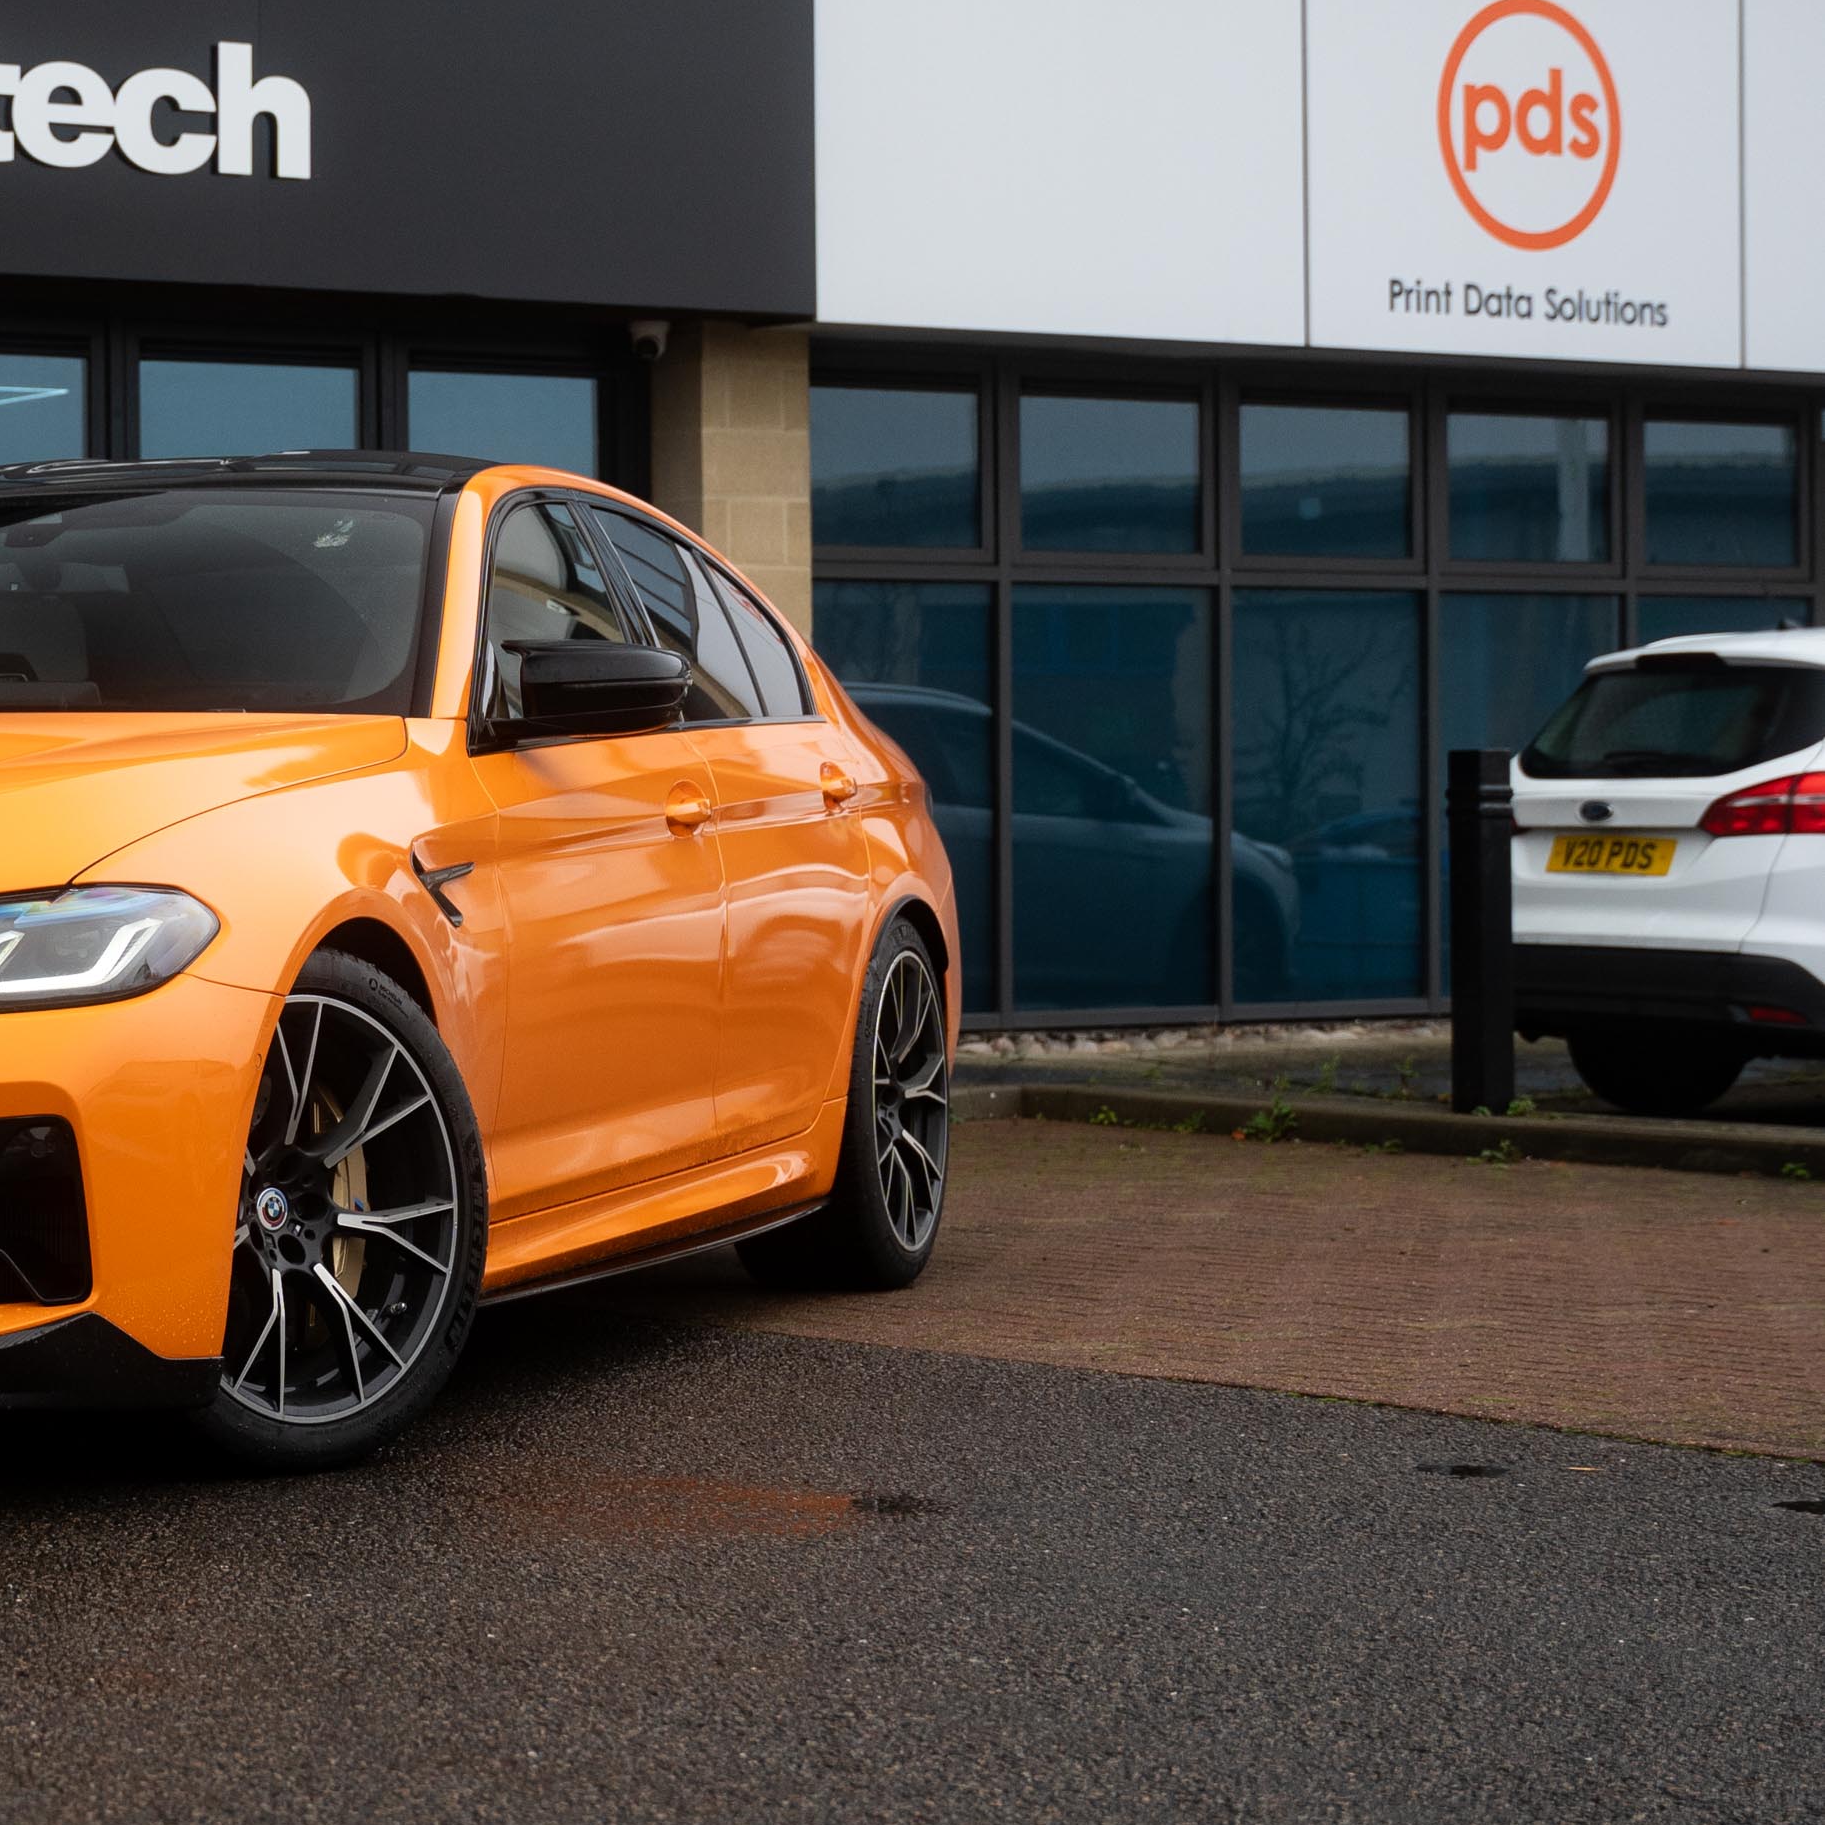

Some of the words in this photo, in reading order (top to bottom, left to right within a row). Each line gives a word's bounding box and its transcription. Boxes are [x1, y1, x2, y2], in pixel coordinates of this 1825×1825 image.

[1463, 67, 1601, 173] pds
[1388, 279, 1453, 314] Print
[1464, 284, 1533, 320] Data
[1544, 287, 1669, 328] Solutions
[1562, 839, 1605, 867] V20
[1605, 840, 1657, 870] PDS
